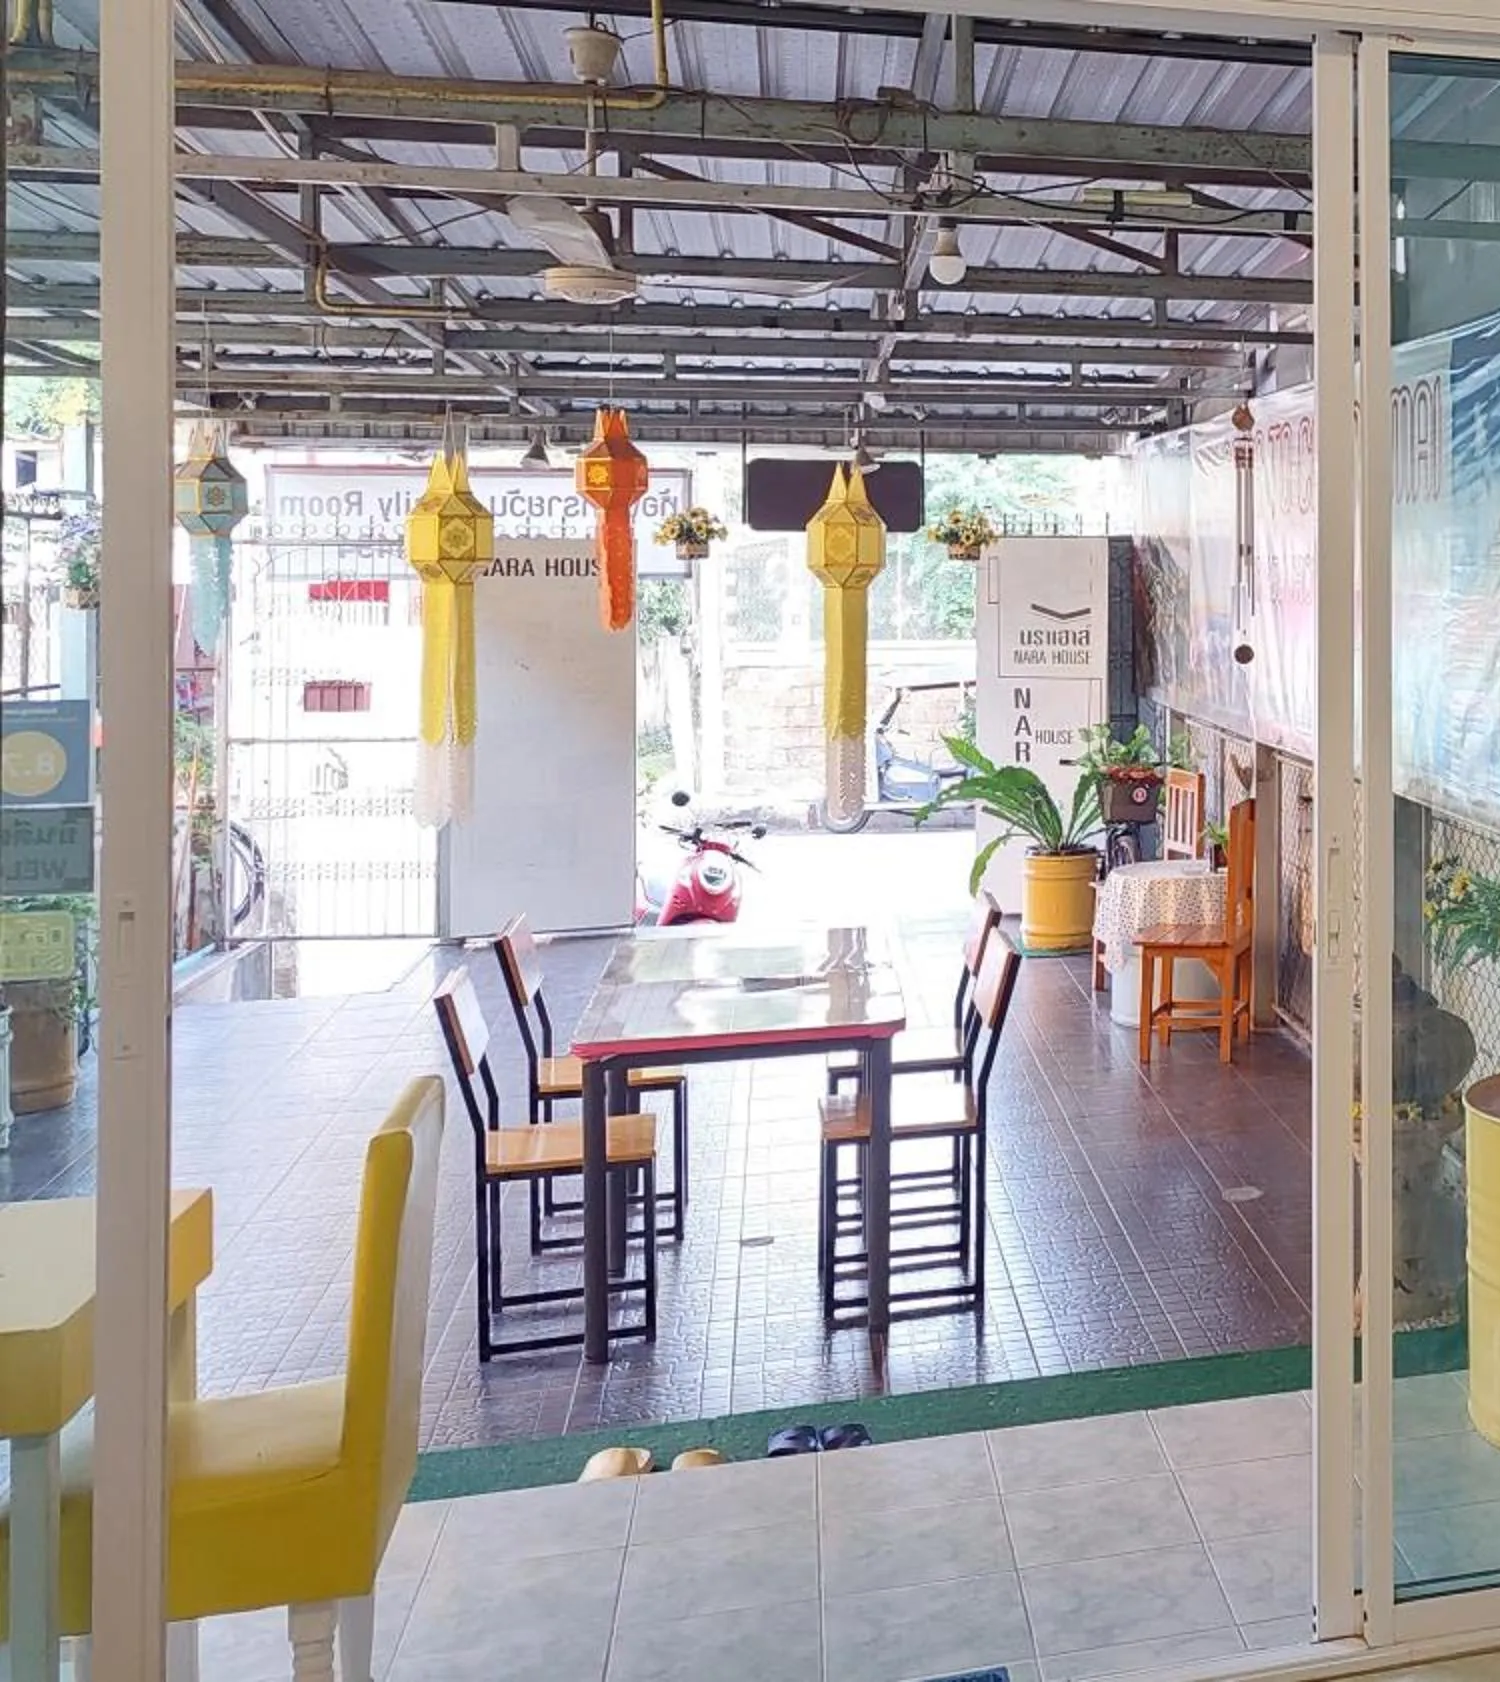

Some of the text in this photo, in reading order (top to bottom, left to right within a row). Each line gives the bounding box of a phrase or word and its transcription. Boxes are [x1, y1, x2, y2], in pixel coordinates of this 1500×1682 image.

[545, 557, 602, 577] HOUS
[1014, 650, 1091, 664] NARA HOUSE
[1013, 688, 1032, 762] NAR
[1035, 729, 1073, 744] HOUSE
